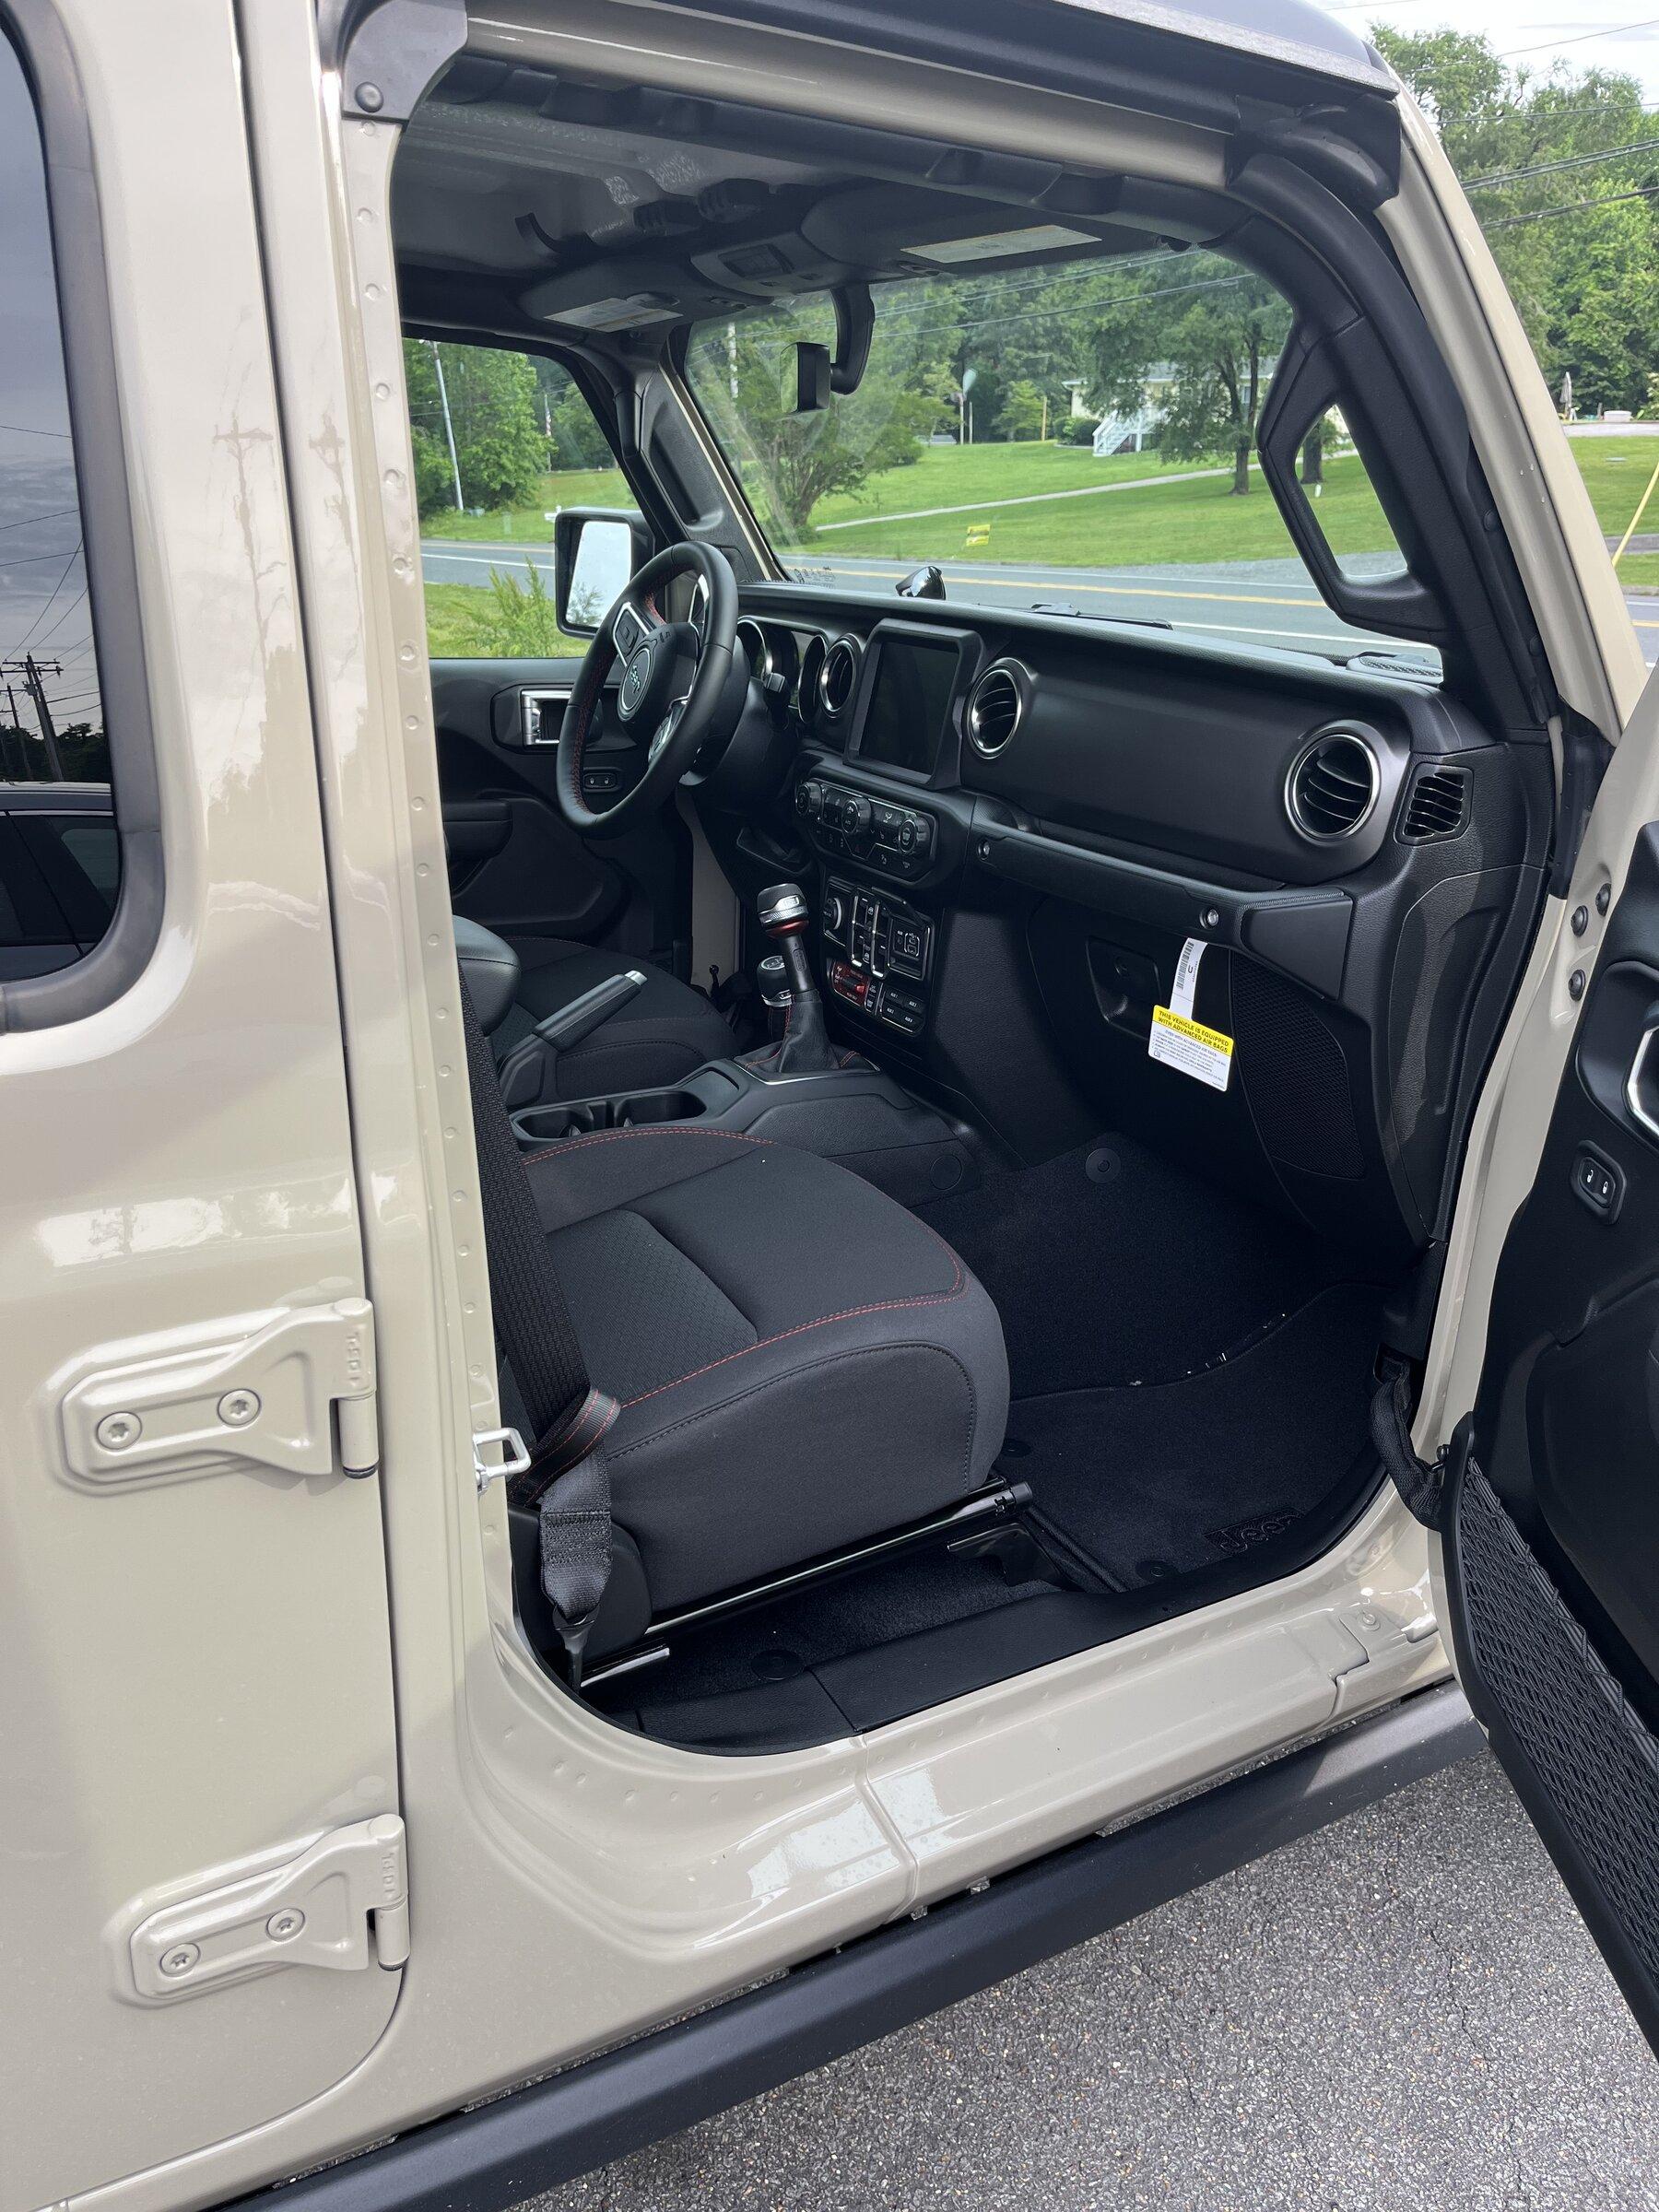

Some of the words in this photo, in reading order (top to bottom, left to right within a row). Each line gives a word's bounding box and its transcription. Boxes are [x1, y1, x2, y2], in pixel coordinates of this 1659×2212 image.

[1158, 1016, 1171, 1026] WITH
[1172, 1023, 1201, 1041] ADVANCED
[1202, 1037, 1212, 1045] AIR
[1213, 1041, 1227, 1053] BAGS
[1159, 1010, 1171, 1019] THIS
[1172, 1016, 1194, 1030] VEHICLE
[1201, 1030, 1229, 1047] EQUIPPED
